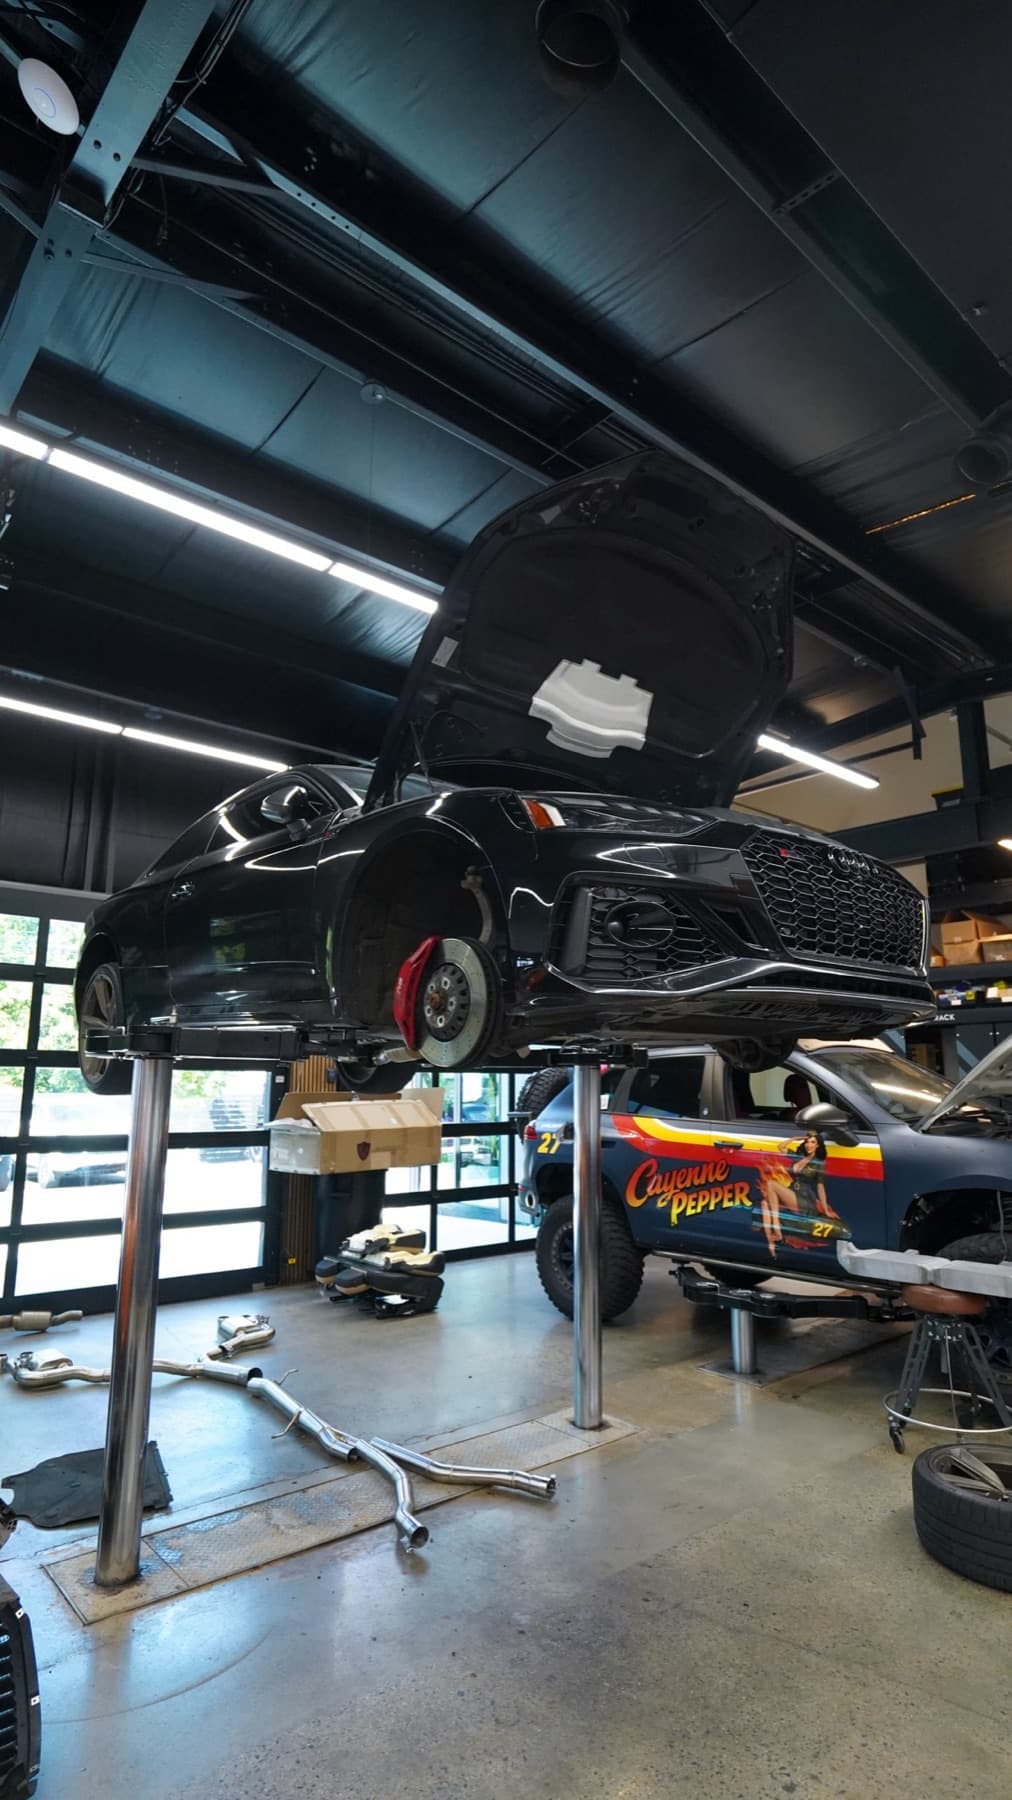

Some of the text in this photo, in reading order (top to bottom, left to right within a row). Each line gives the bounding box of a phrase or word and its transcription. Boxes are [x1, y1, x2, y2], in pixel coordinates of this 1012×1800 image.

[537, 1132, 560, 1154] 27
[625, 1157, 730, 1208] Cayenne
[670, 1181, 753, 1226] PEPPER
[812, 1222, 834, 1238] 27
